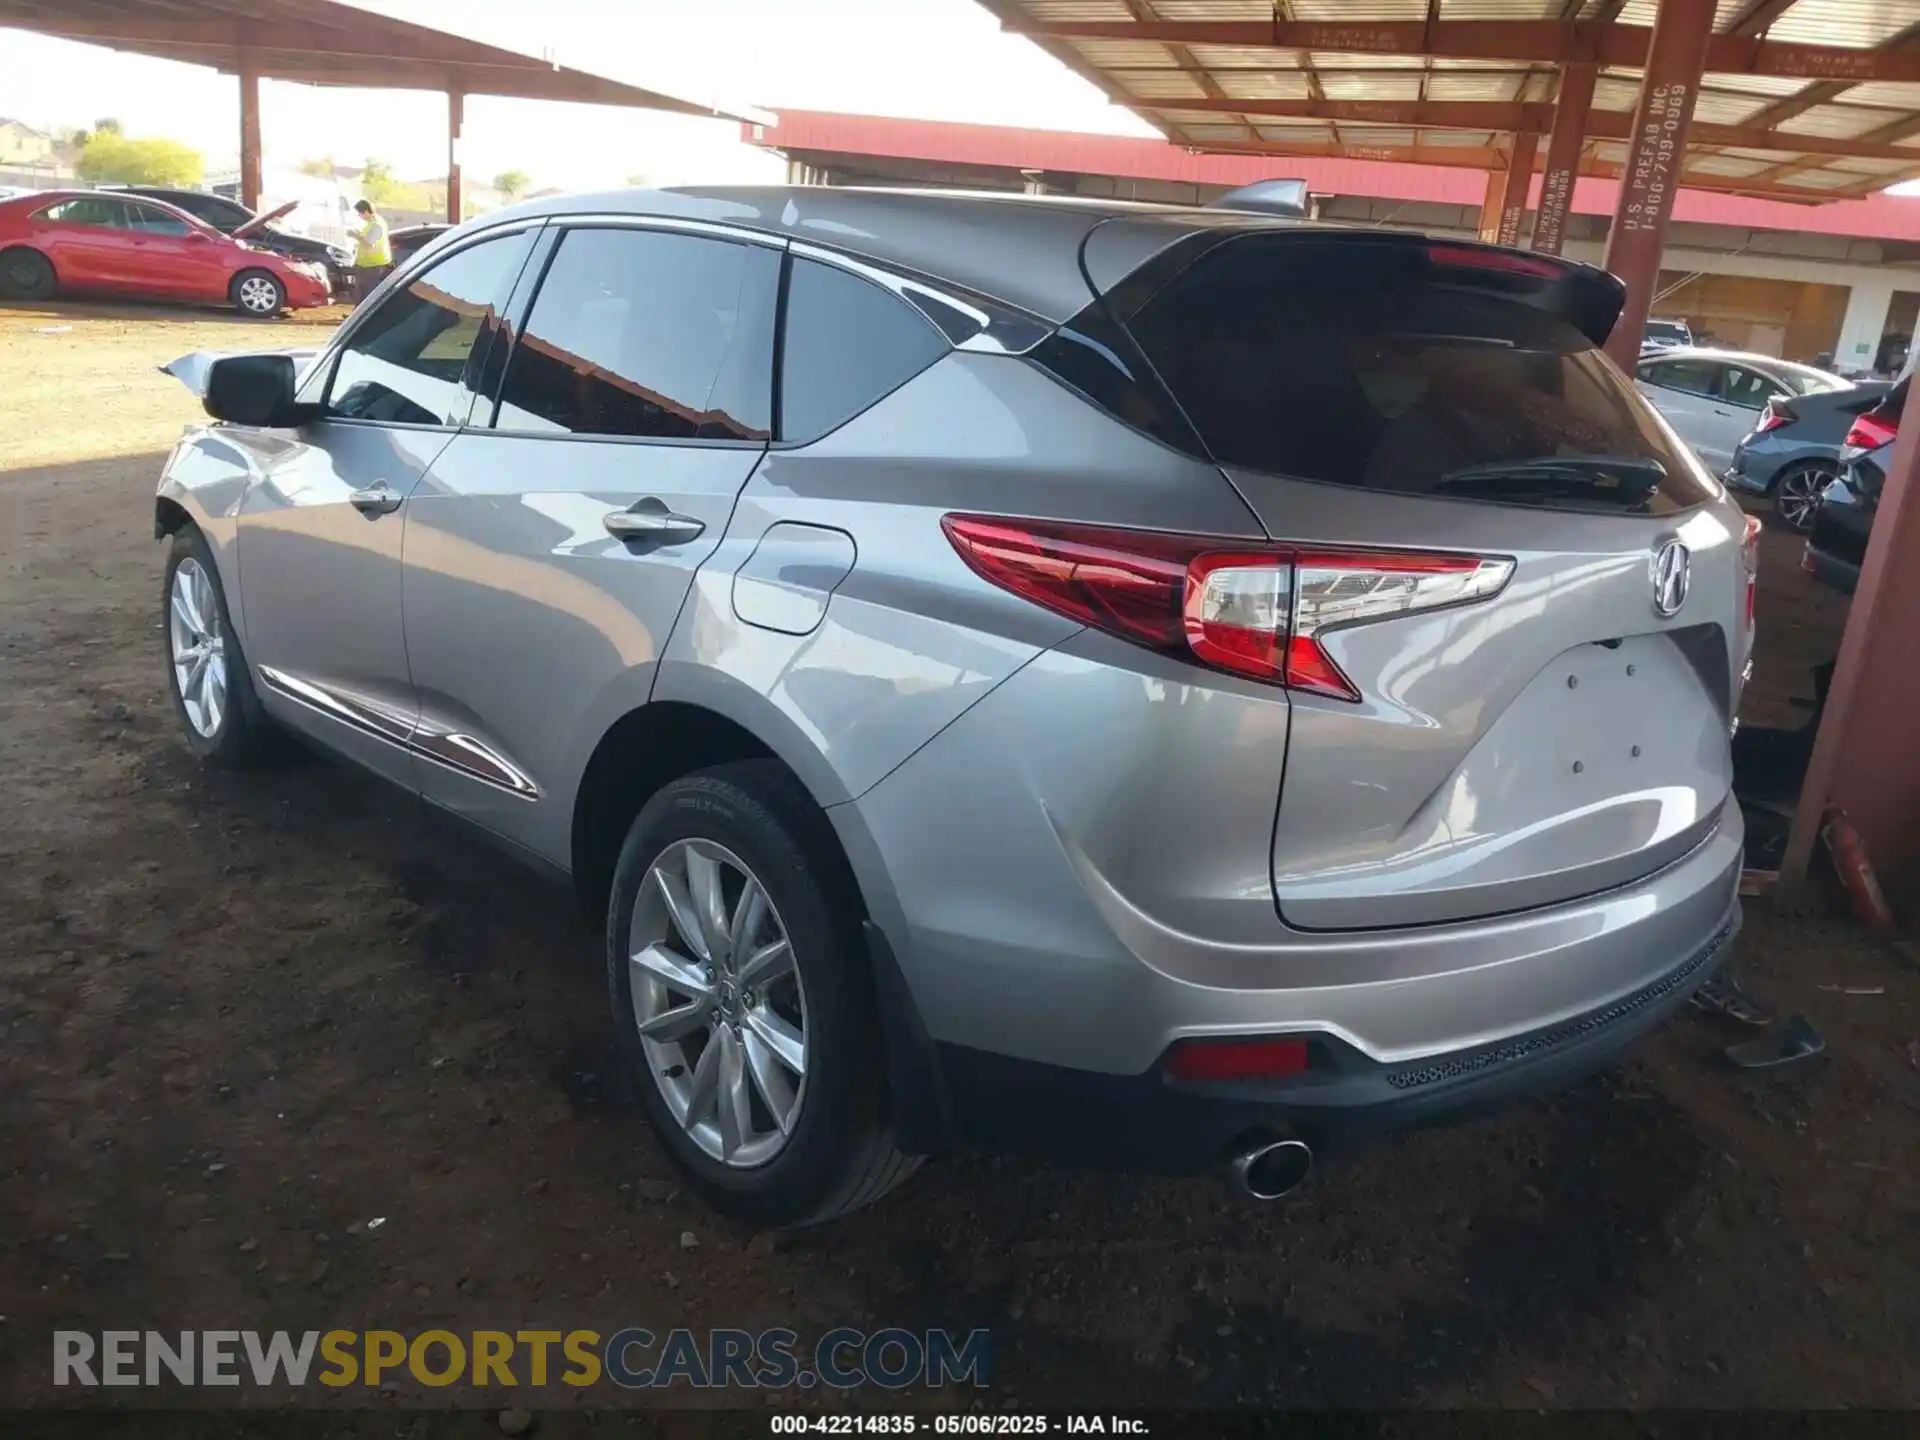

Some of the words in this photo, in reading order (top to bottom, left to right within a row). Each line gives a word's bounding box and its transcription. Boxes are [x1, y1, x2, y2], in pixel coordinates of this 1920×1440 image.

[1650, 83, 1670, 115] INC.
[1632, 123, 1660, 189] PREFAB
[1624, 199, 1644, 230] U.S.
